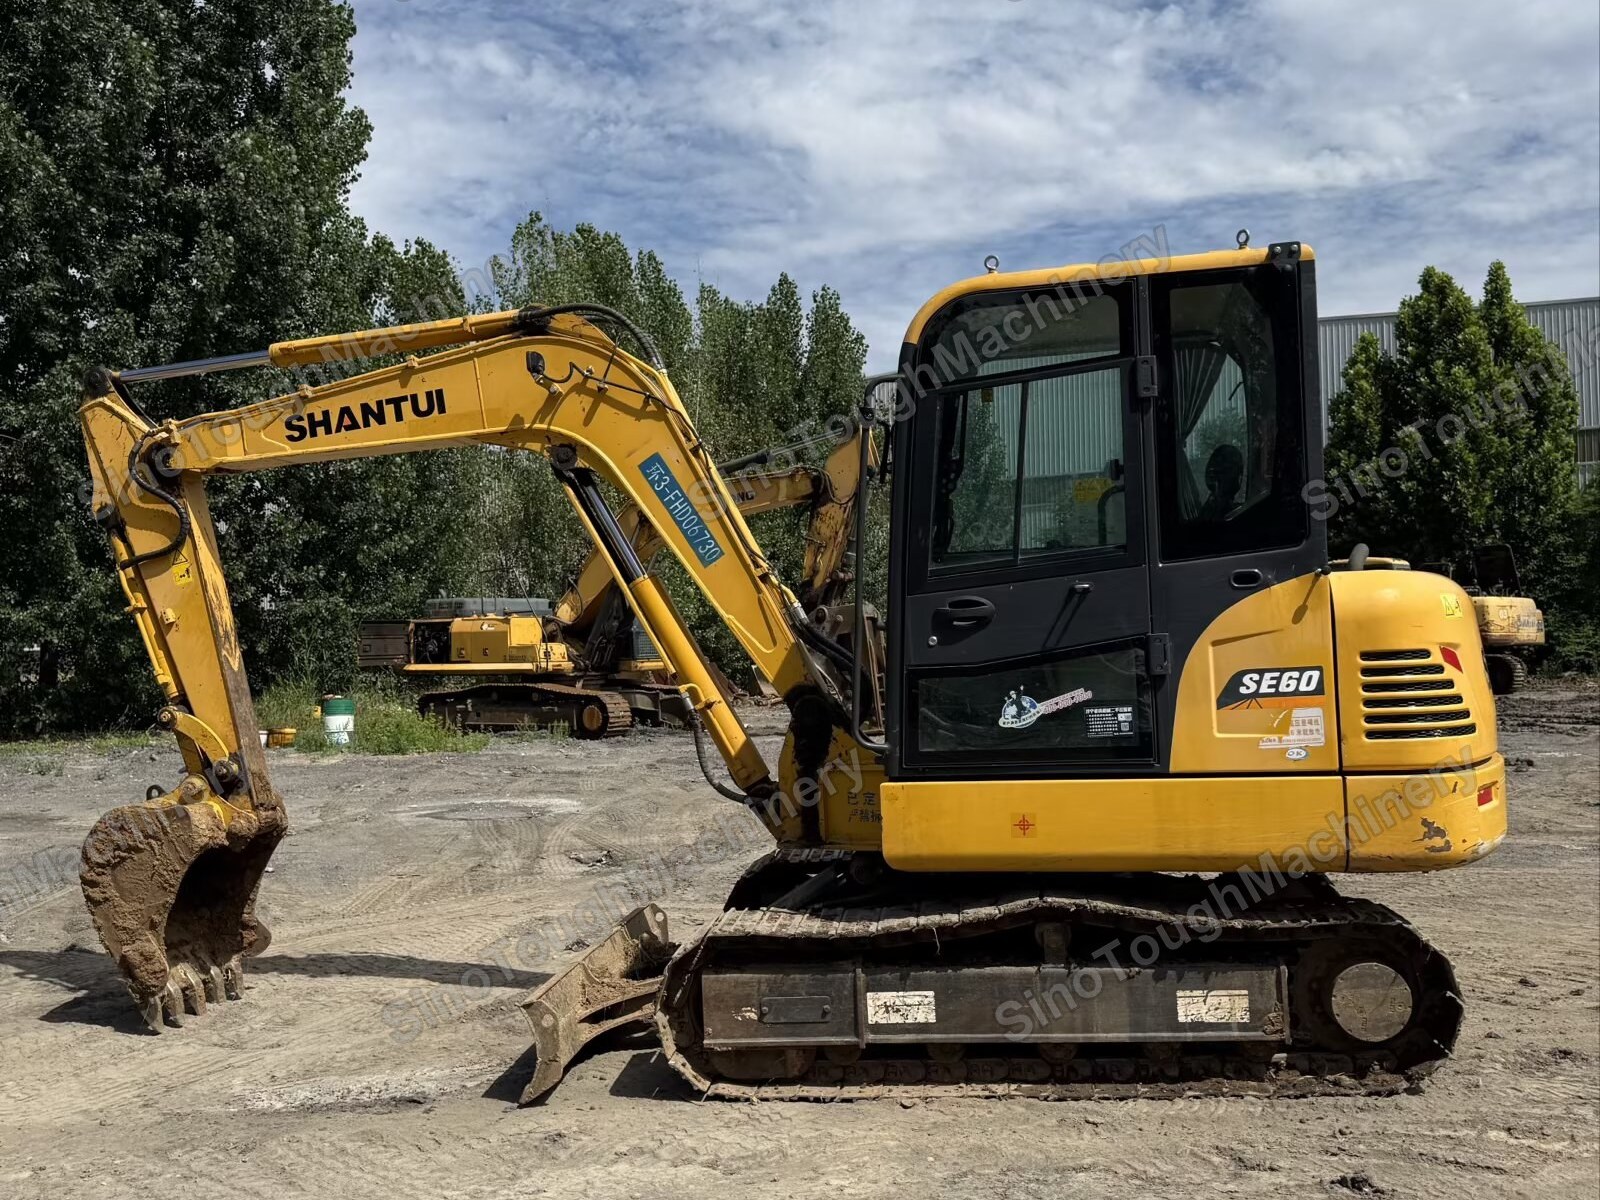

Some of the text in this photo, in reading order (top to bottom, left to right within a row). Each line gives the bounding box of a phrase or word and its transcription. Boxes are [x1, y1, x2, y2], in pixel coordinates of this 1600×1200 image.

[285, 388, 447, 443] SHANTUI
[646, 462, 721, 561] 环3-FHD06730
[1239, 670, 1321, 694] SE60
